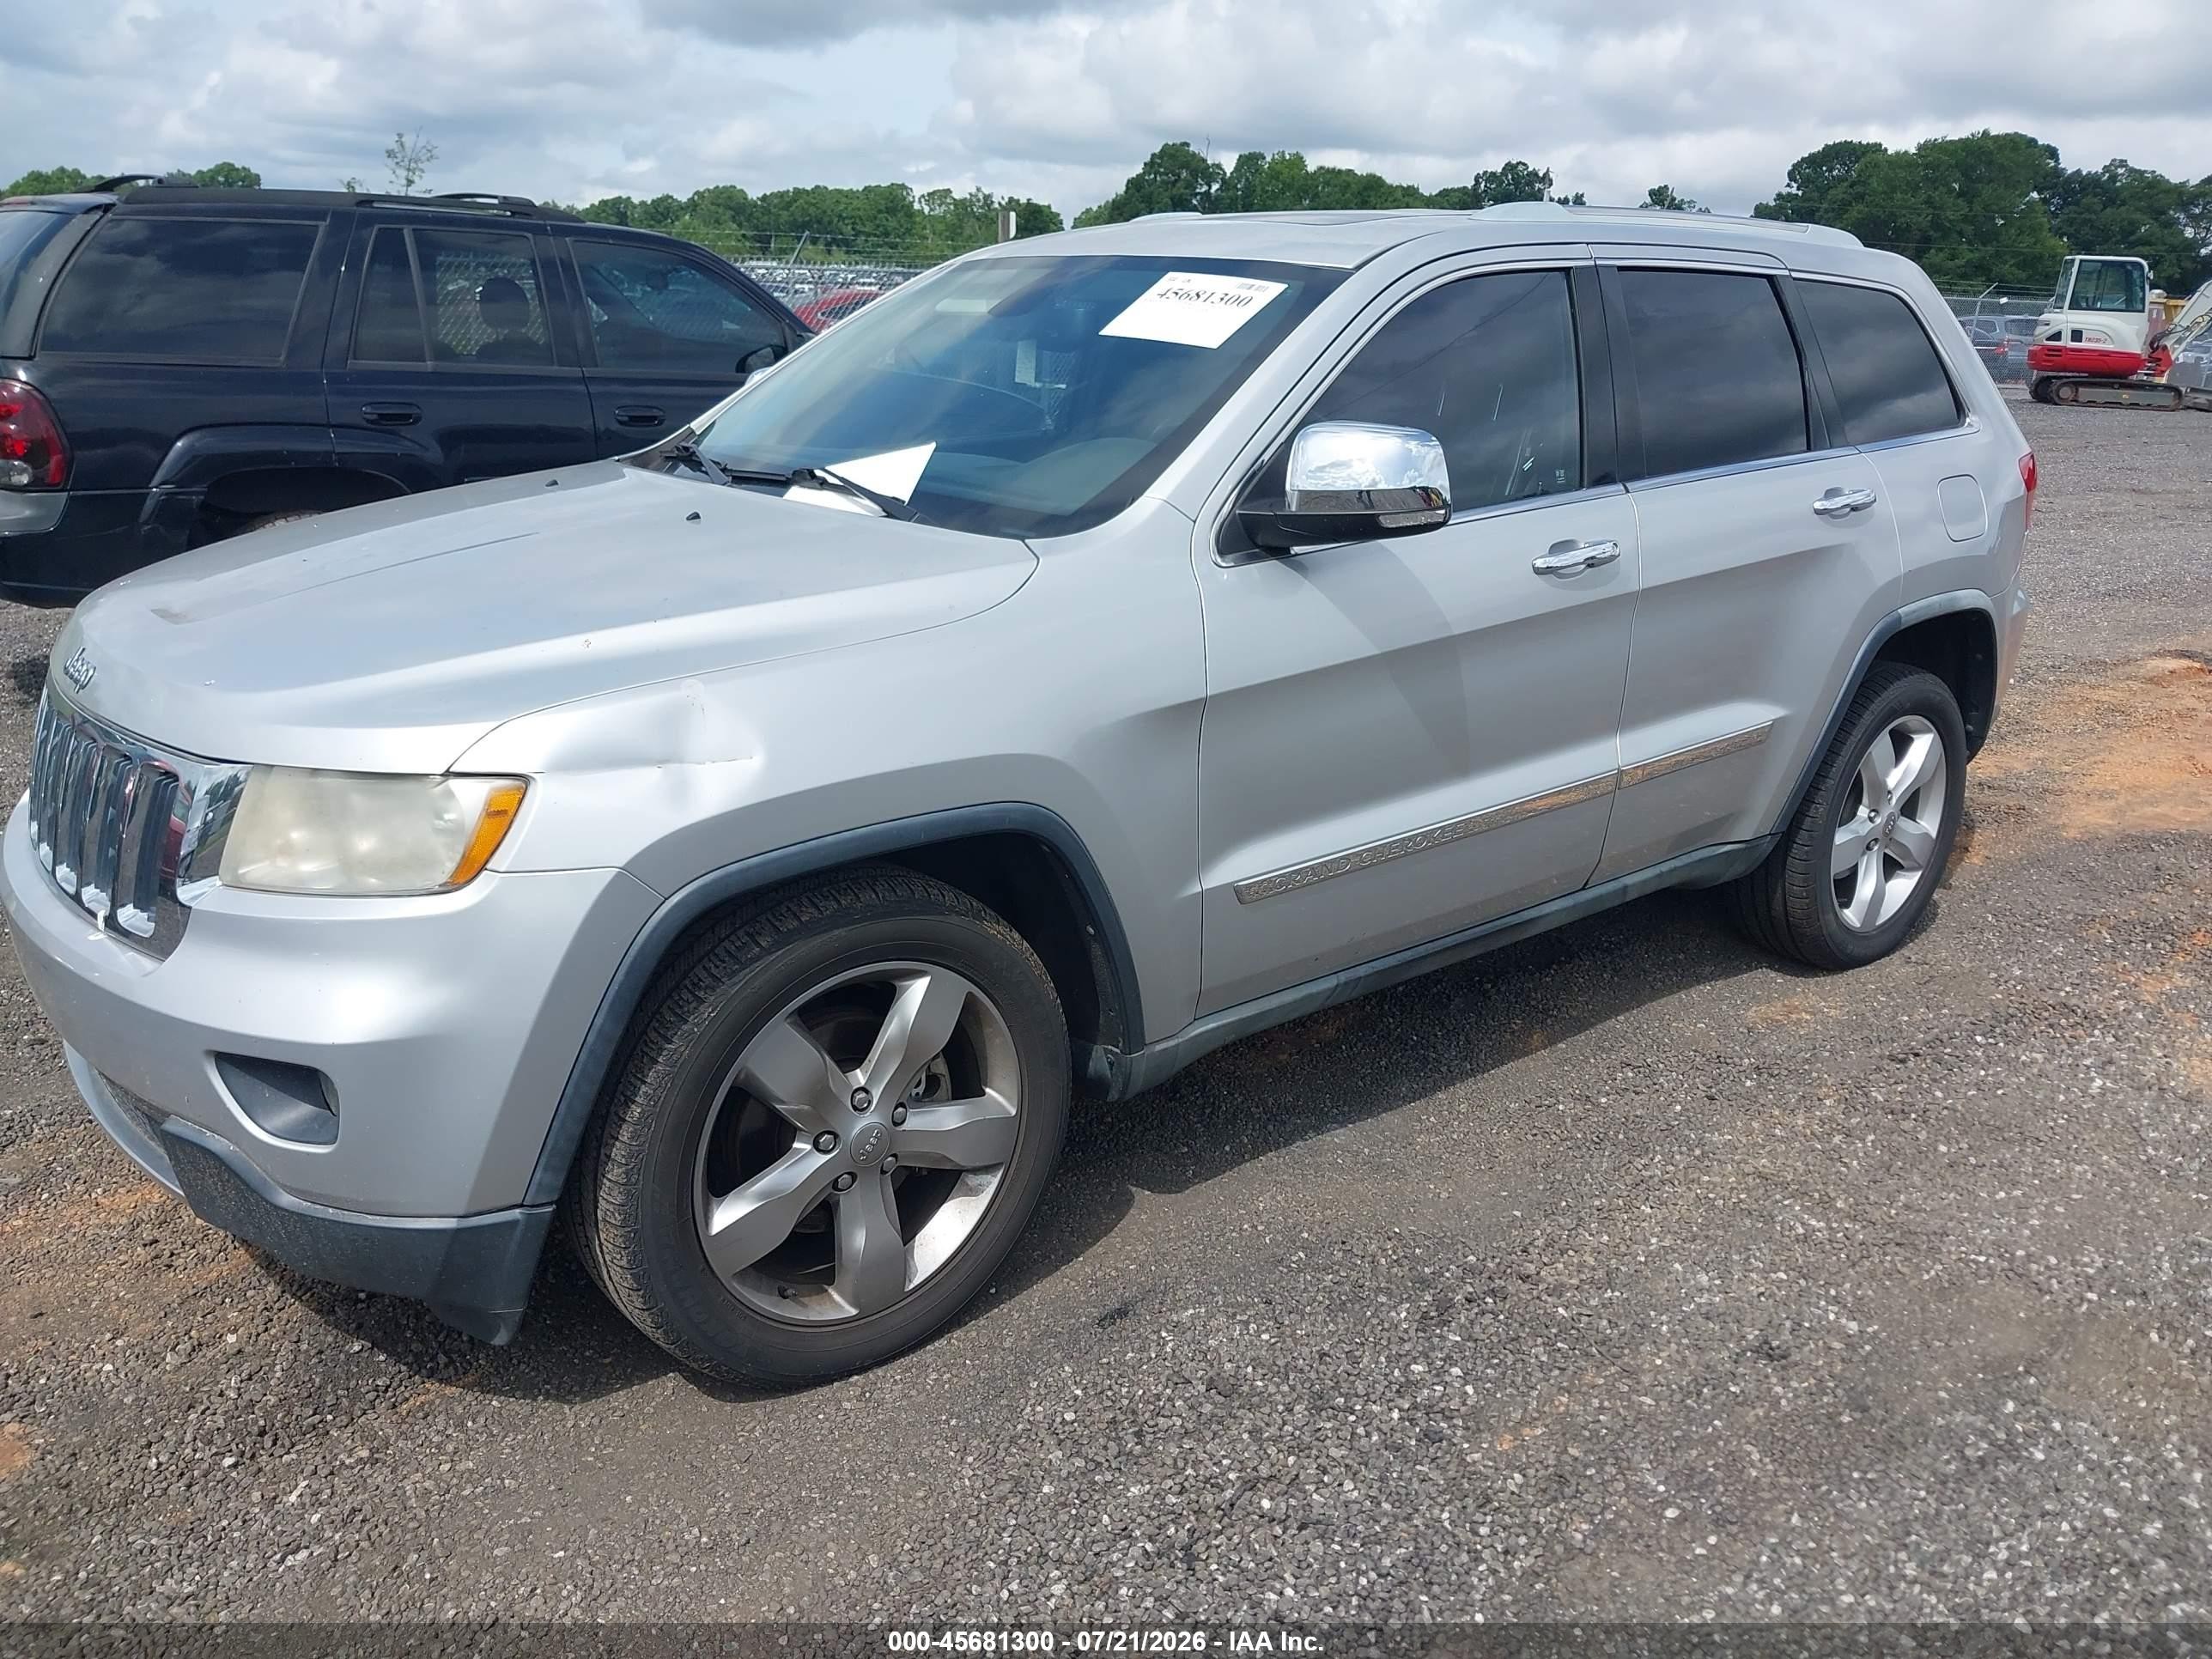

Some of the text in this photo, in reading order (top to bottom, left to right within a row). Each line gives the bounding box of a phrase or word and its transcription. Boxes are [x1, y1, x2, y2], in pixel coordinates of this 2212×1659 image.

[1157, 288, 1254, 308] 45681300
[64, 647, 96, 694] Jeep
[1273, 823, 1466, 892] GRAND CHEROKEE
[859, 1128, 881, 1160] Jeep
